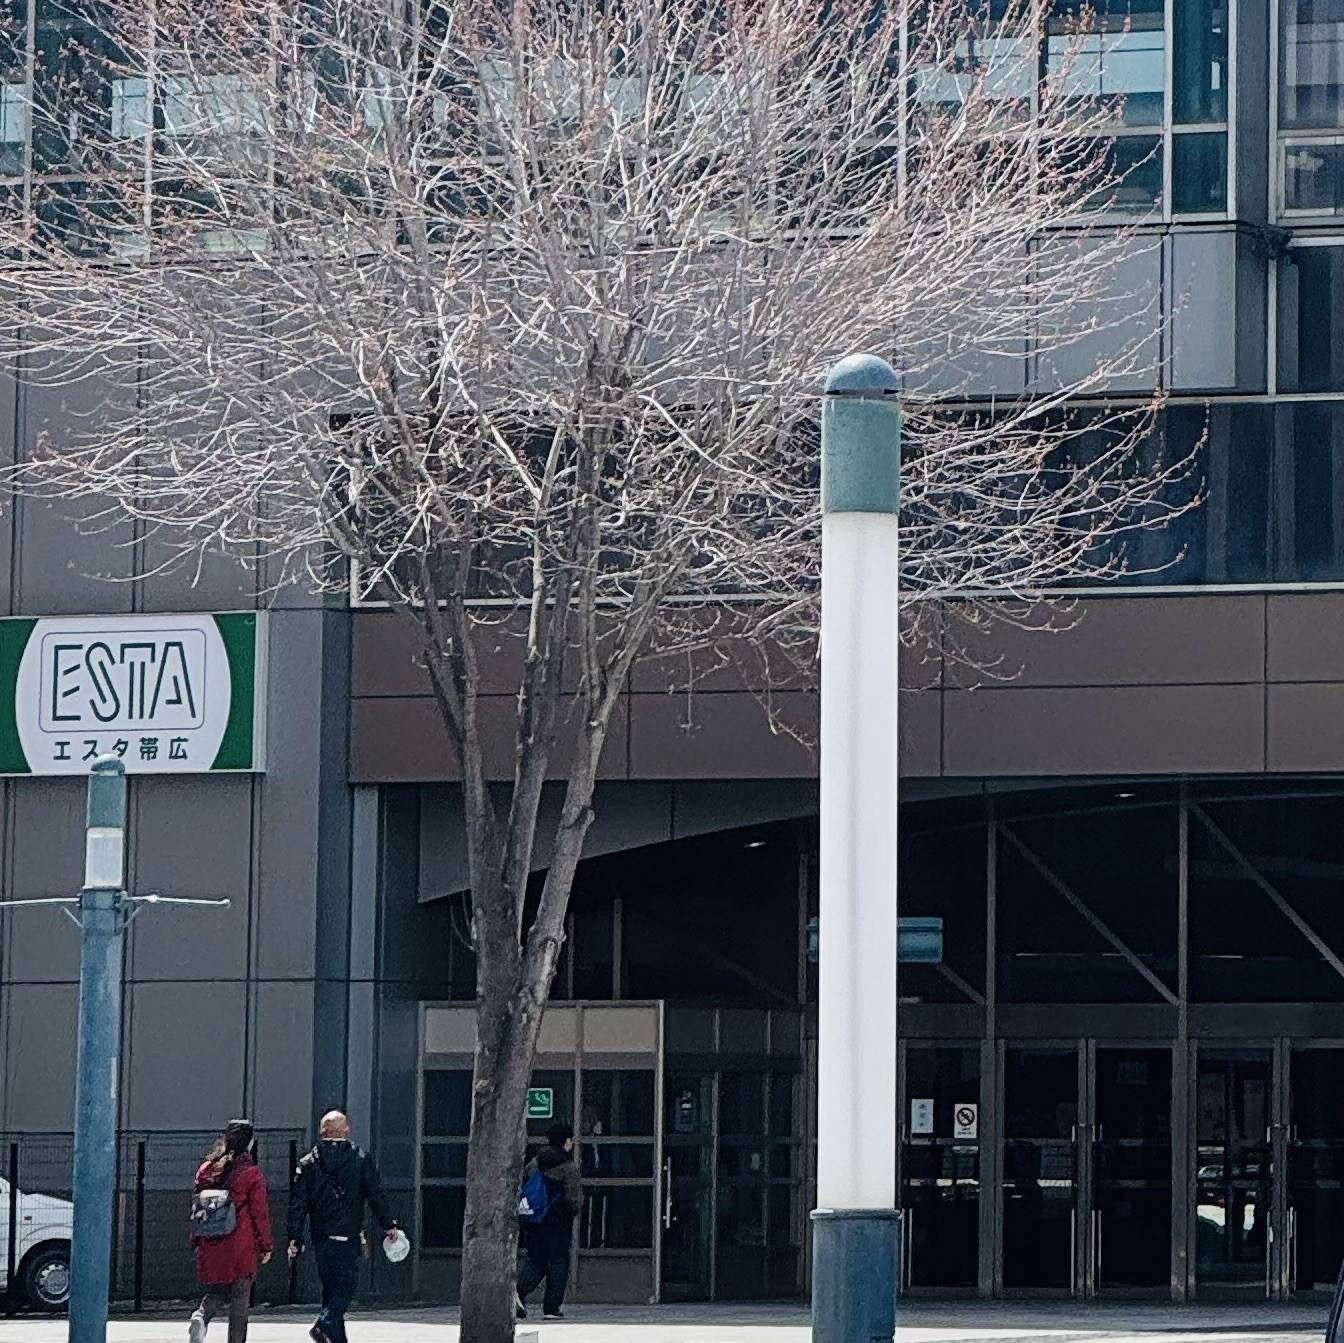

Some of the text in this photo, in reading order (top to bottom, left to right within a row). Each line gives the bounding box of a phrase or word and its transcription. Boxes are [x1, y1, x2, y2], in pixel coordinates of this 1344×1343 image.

[52, 641, 197, 723] ESTA
[53, 736, 189, 761] エスタ帯広
